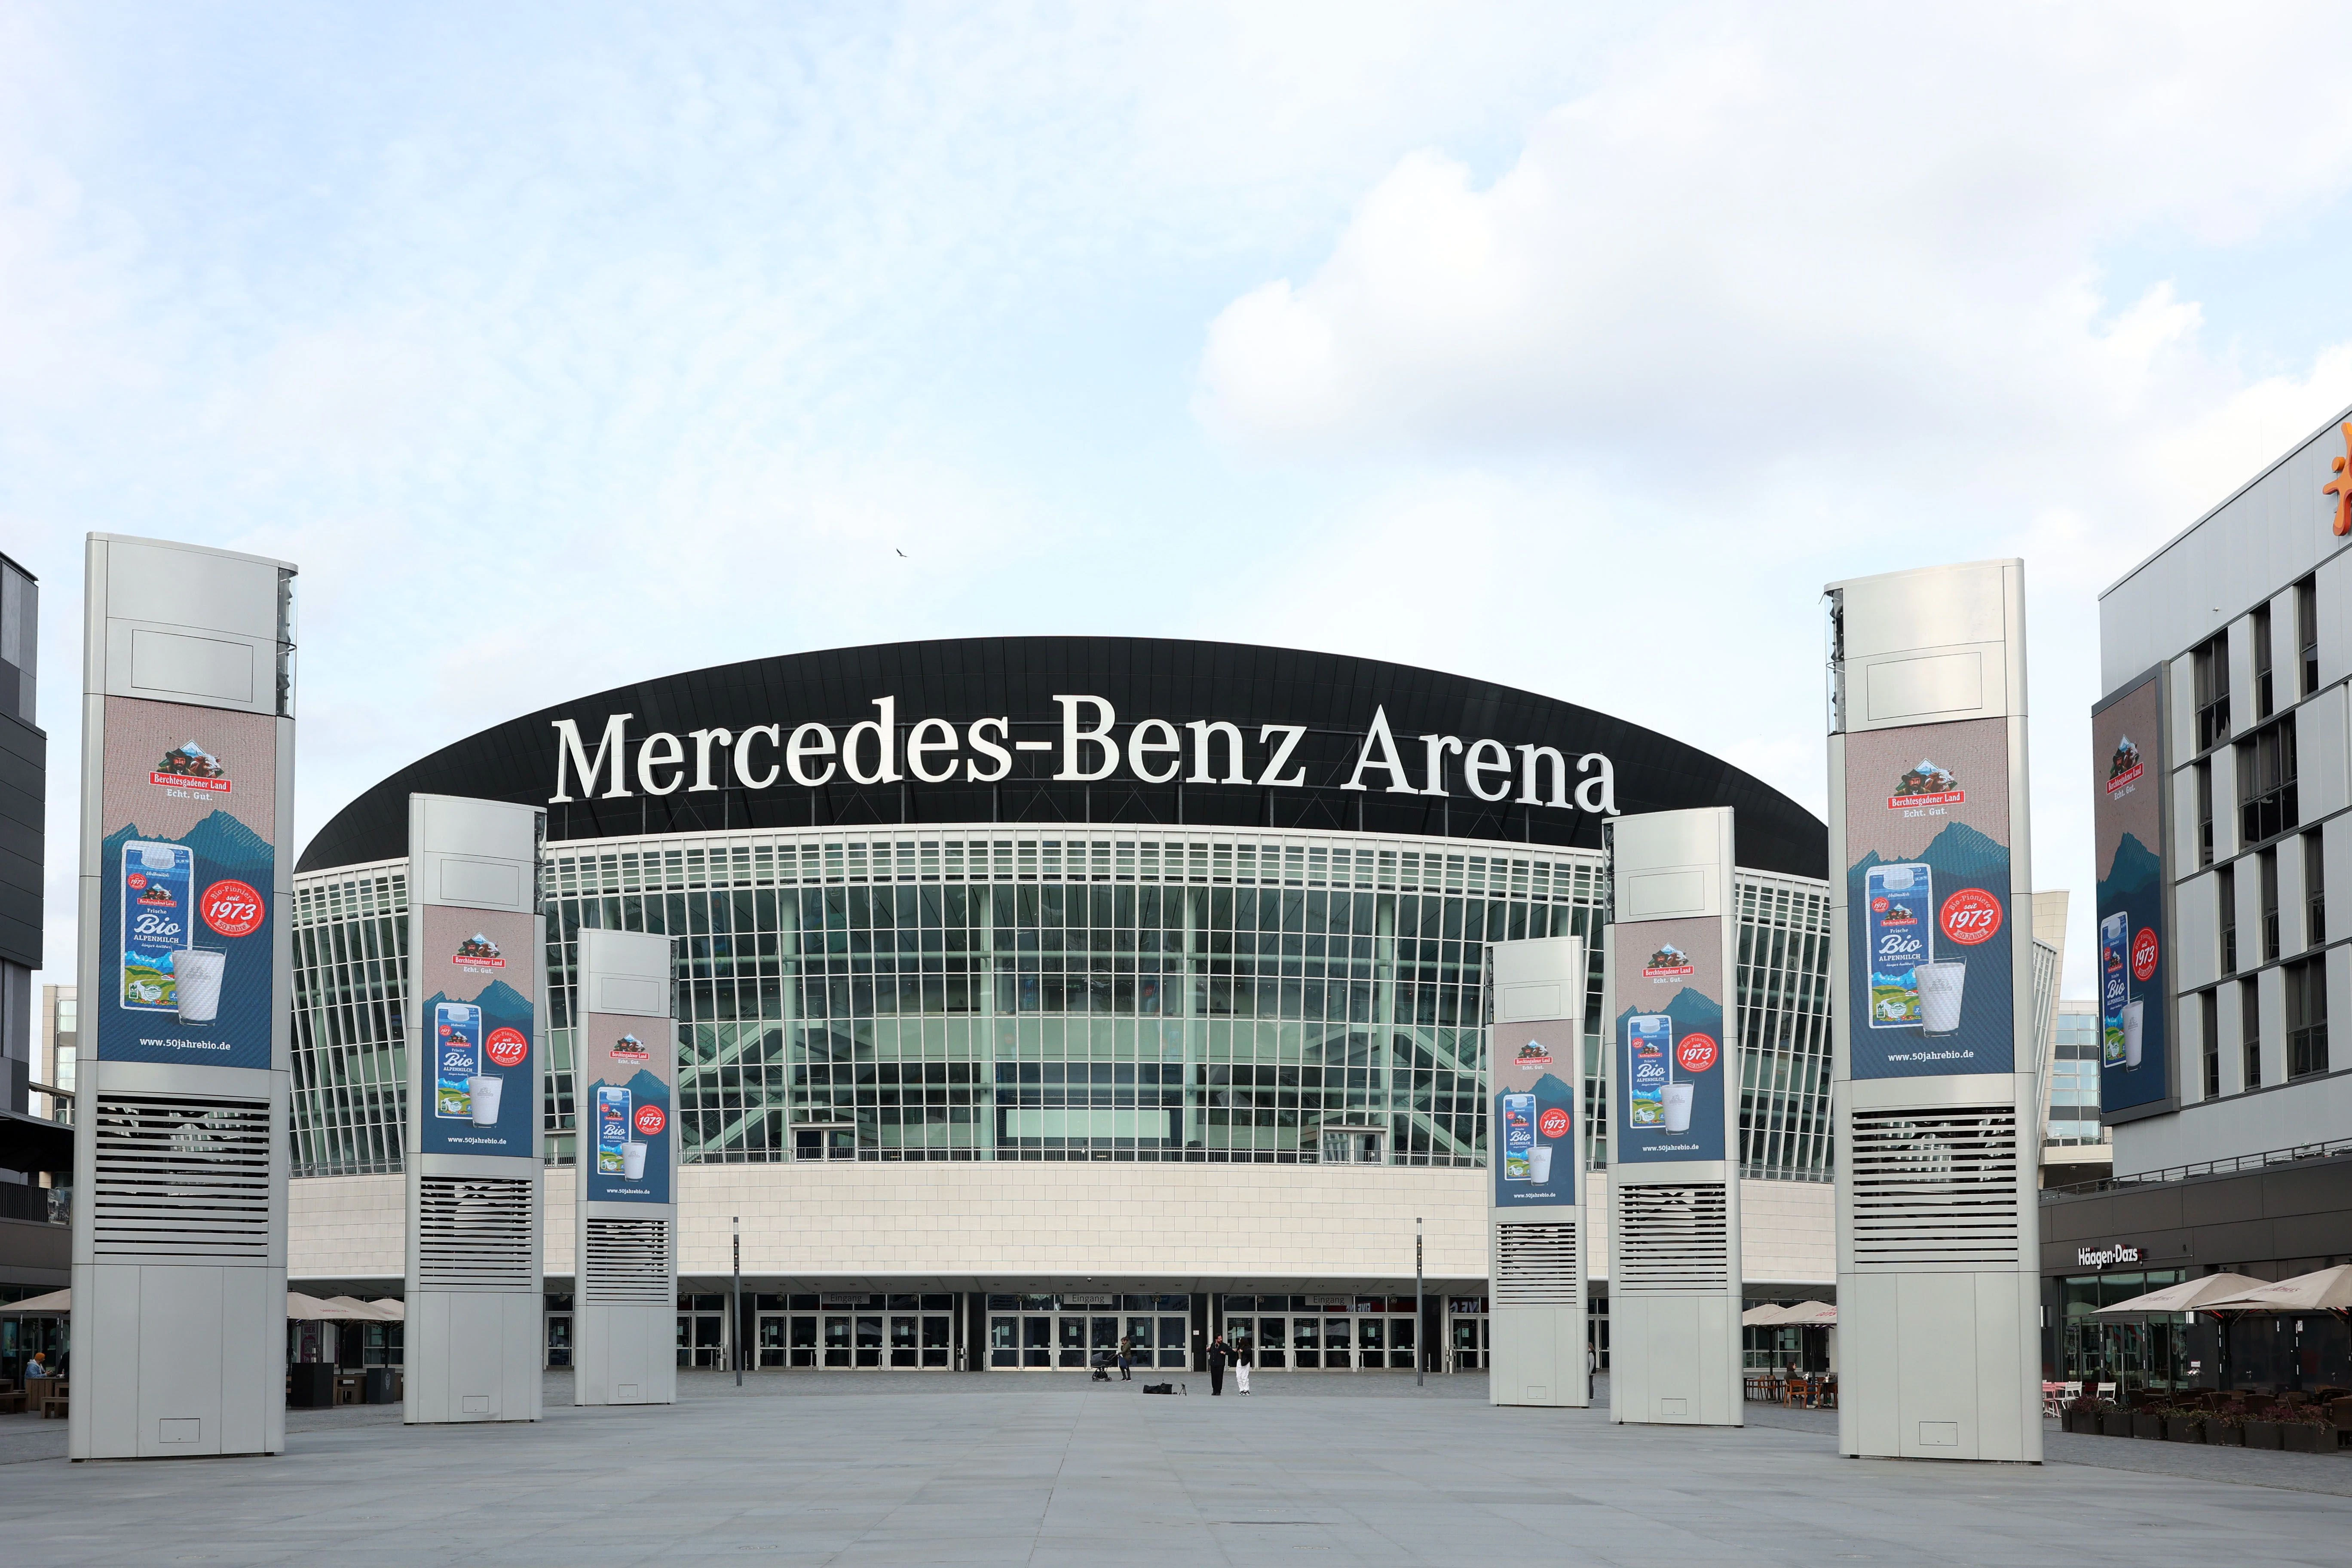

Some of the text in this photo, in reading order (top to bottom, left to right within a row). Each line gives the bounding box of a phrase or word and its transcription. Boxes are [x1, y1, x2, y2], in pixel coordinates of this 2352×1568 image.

[548, 695, 1620, 815] Mercedes-Benz Arena
[154, 774, 227, 790] Berchtesgadener Land
[2109, 772, 2133, 791] Berchtesgadener
[167, 789, 213, 800] Echt. Gut.
[2114, 784, 2135, 800] Echt. Gut.
[1892, 793, 1960, 806] Berchtesgadener Land
[1904, 807, 1948, 818] Echt. Gut.
[210, 885, 254, 902] Bio-Pioniere
[1948, 894, 1991, 910] Bio-Pioniere
[210, 901, 257, 920] 1973
[134, 914, 181, 935] Bio
[1949, 909, 1994, 928] 1973
[133, 934, 179, 943] ALPENMILCH
[1966, 931, 1985, 939] Jahre
[1879, 934, 1922, 954] Bio
[456, 956, 490, 965] Berchtesgadener
[2135, 945, 2155, 967] 1973
[2107, 979, 2125, 999] Bio
[140, 1038, 230, 1050] www.50jahrebio.de
[492, 1042, 523, 1055] 1973
[443, 1052, 474, 1067] Bio
[1682, 1047, 1712, 1060] 1973
[1888, 1049, 1974, 1062] www.50jahrebio.de
[1636, 1063, 1666, 1077] Bio
[639, 1116, 662, 1126] 1973
[1544, 1119, 1566, 1129] 1973
[603, 1124, 626, 1135] Bio
[448, 1136, 506, 1145] www.50jahrebio.de
[1510, 1131, 1531, 1142] Bio
[1642, 1143, 1699, 1152] www.50jahrebio.de
[2078, 1244, 2138, 1269] Häagen-Dazs
[830, 1294, 862, 1303] Eingang
[1072, 1294, 1105, 1304] Eingang
[1313, 1295, 1344, 1305] Eingang
